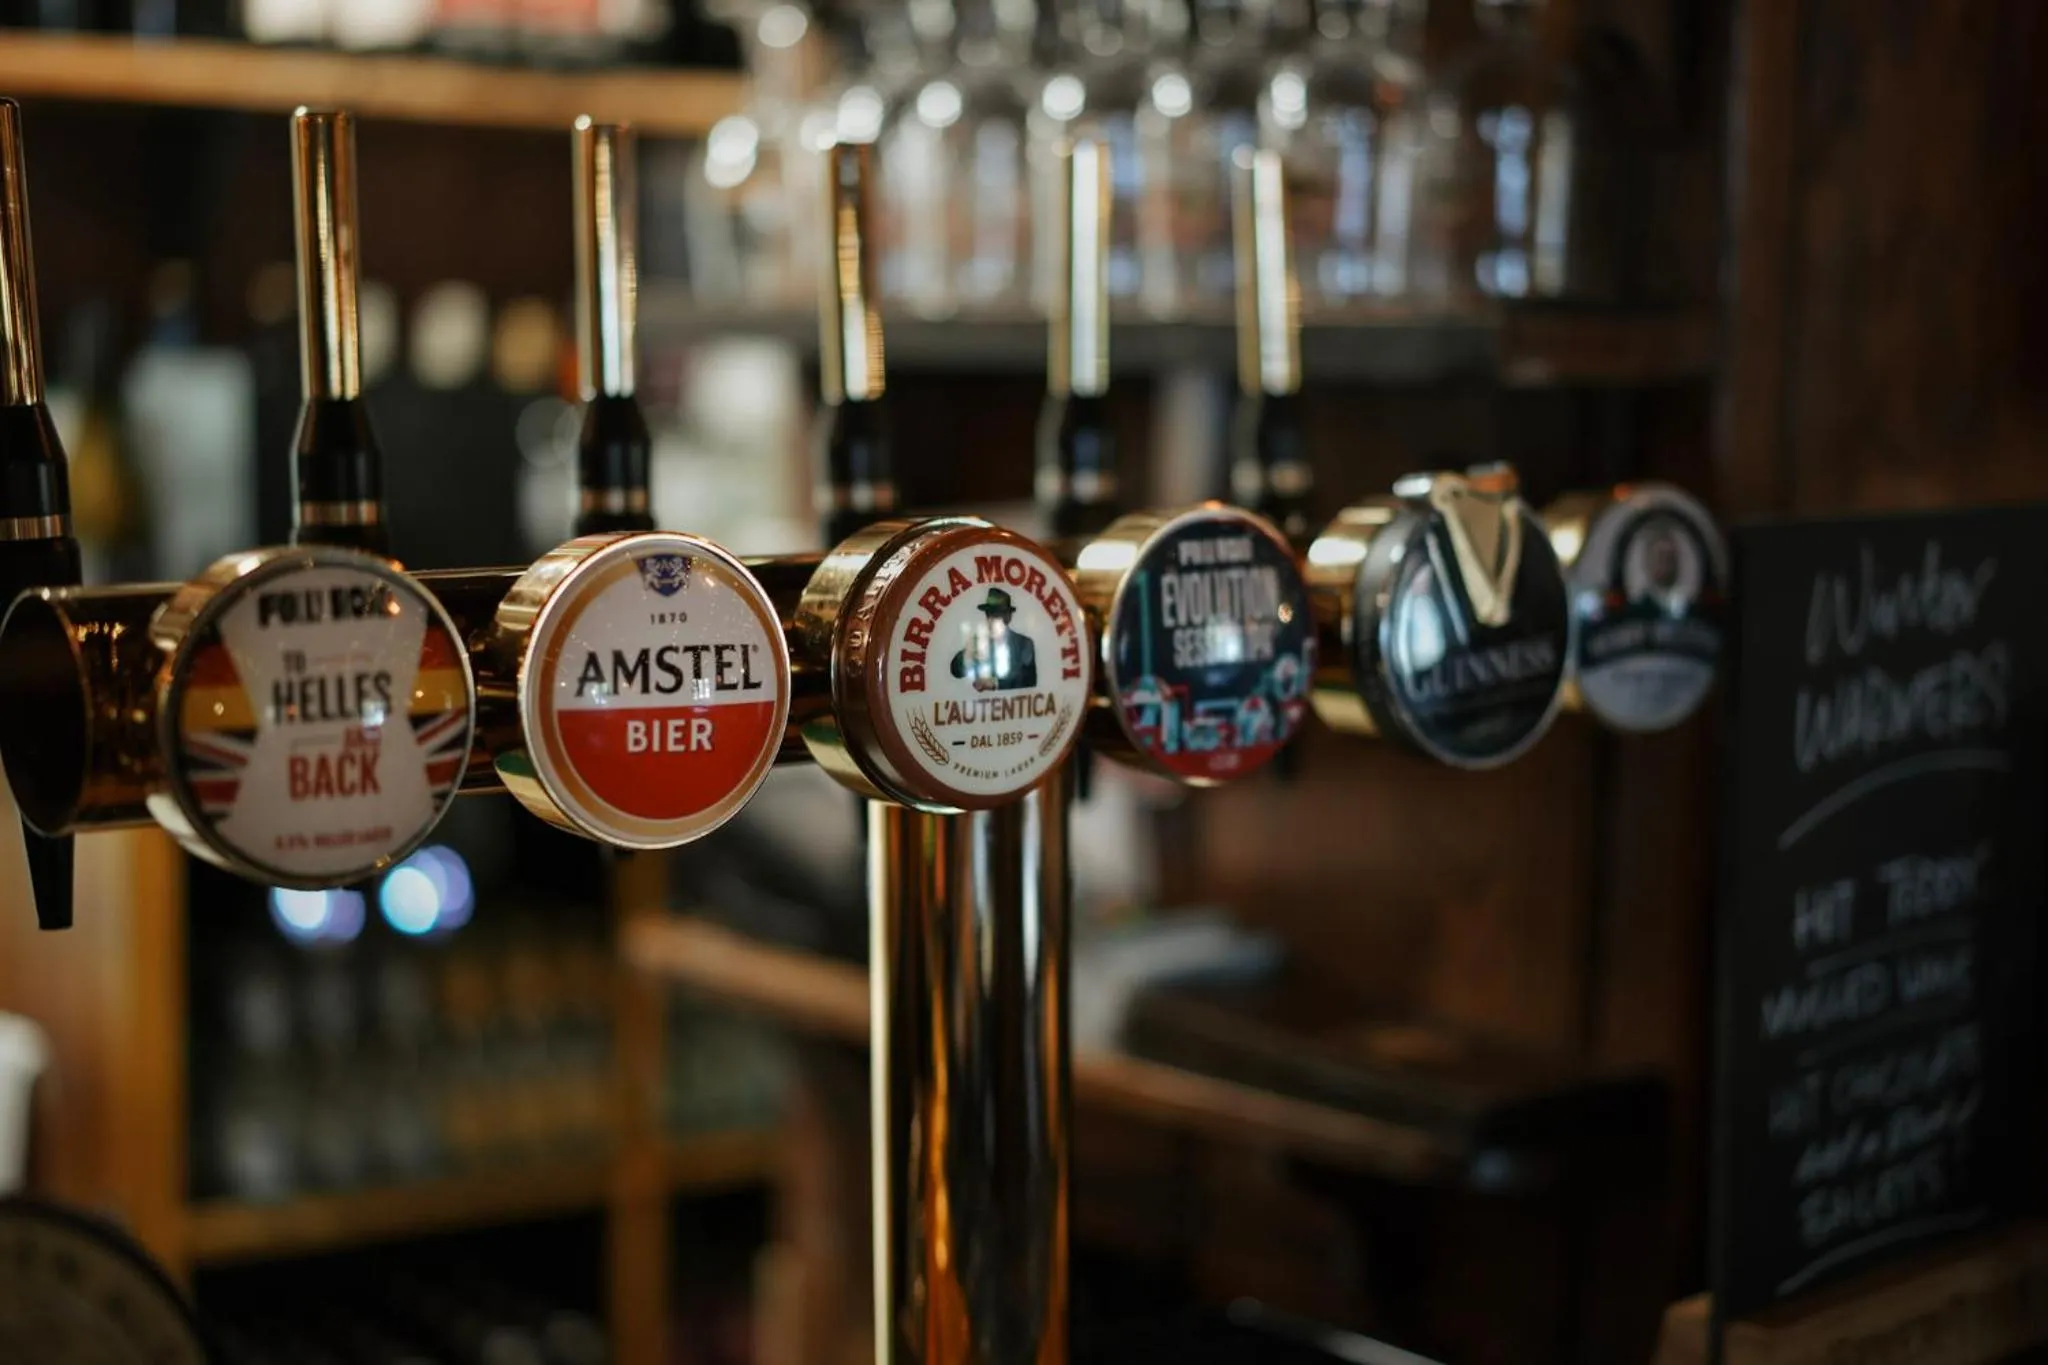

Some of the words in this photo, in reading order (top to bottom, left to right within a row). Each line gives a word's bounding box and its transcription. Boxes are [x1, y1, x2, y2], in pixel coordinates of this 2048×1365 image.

[650, 612, 688, 625] 1870
[900, 566, 973, 693] BIRRA
[975, 555, 1081, 681] MORETTI
[574, 643, 763, 697] AMSTEL
[272, 671, 393, 725] HELLES
[934, 693, 1057, 726] L'AUTENTICA
[626, 718, 713, 753] BIER
[970, 734, 993, 748] DAL
[996, 732, 1023, 747] 1859
[288, 753, 381, 801] BACK
